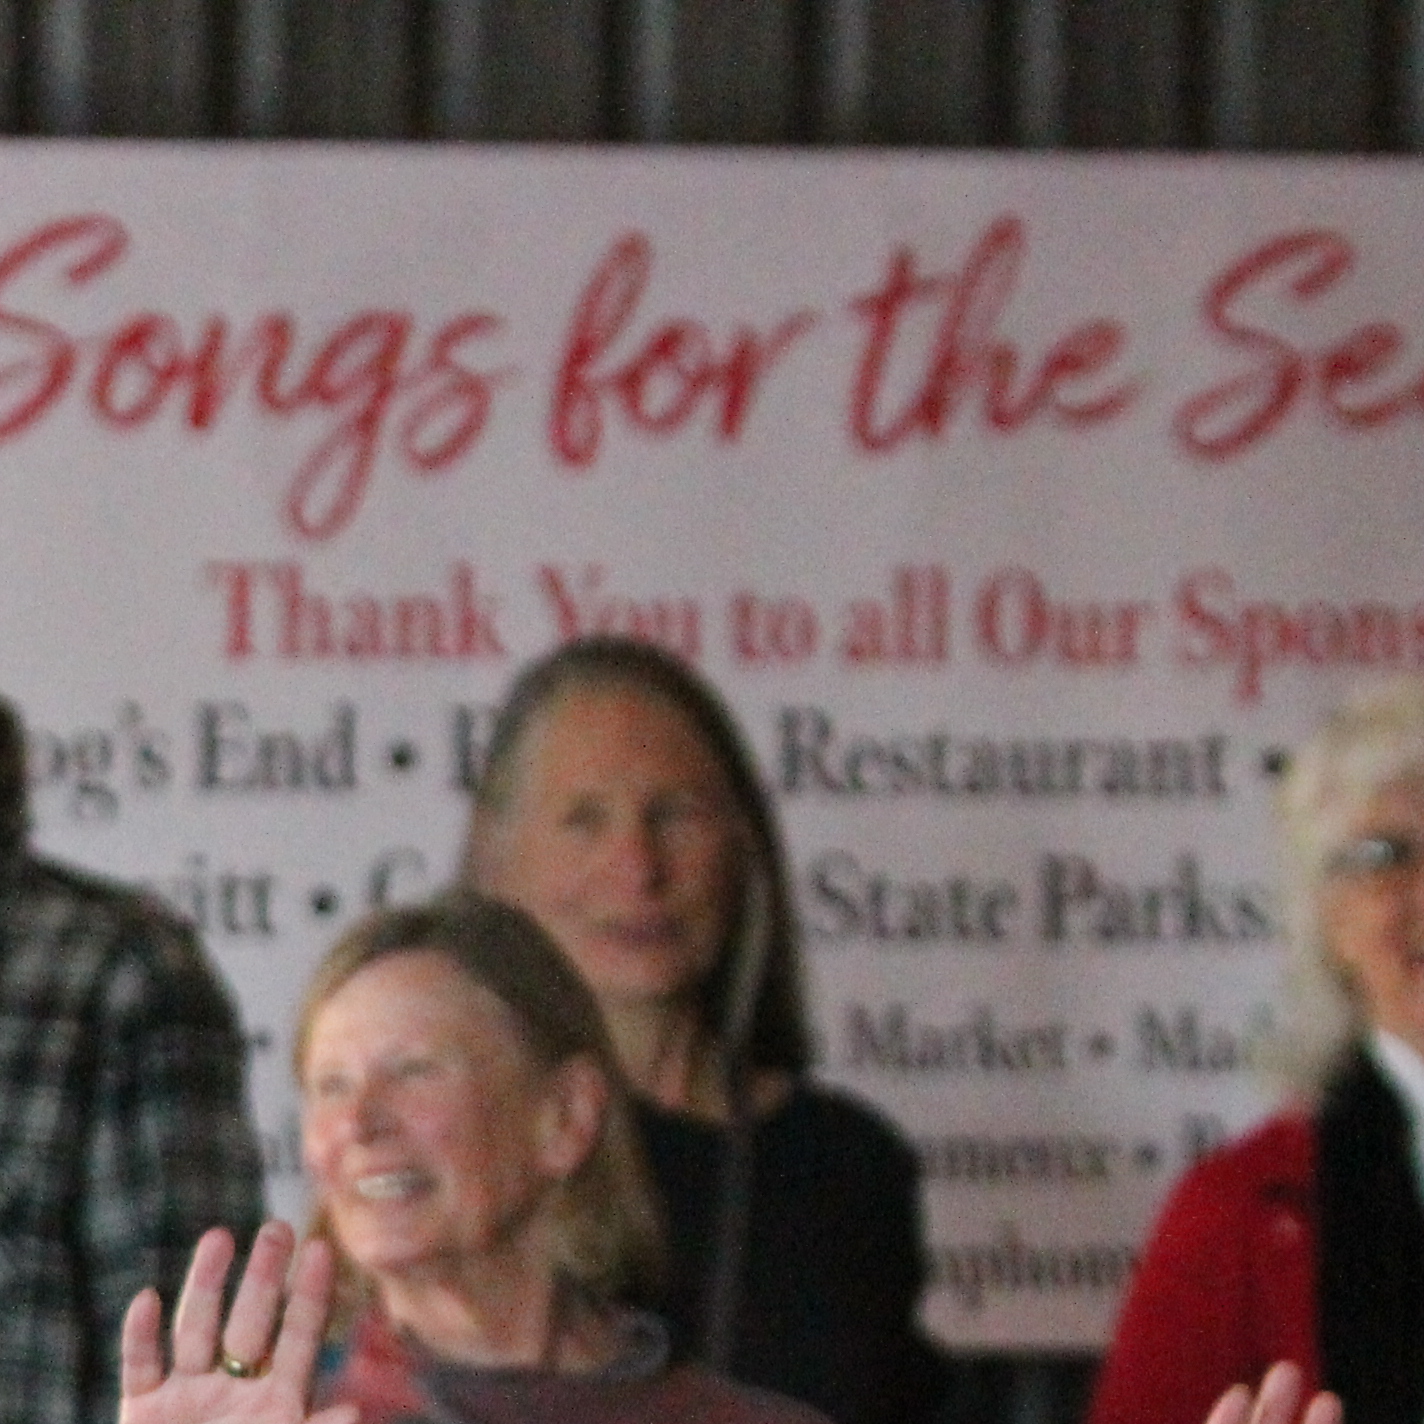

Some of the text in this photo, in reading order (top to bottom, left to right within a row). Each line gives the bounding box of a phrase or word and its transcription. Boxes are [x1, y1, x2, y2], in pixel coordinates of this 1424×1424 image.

[552, 232, 824, 468] for
[847, 214, 1144, 454] the
[1172, 228, 1424, 465] Se
[205, 562, 506, 661] Thank
[732, 592, 820, 662] to
[846, 566, 950, 662] all
[974, 567, 1146, 663] Our
[24, 700, 172, 820] og's
[198, 702, 358, 790] End
[780, 706, 1226, 796] Restaurant
[184, 852, 275, 937] itt
[812, 850, 1016, 941] State
[1044, 851, 1276, 943] Parks
[848, 1002, 1066, 1071] Market
